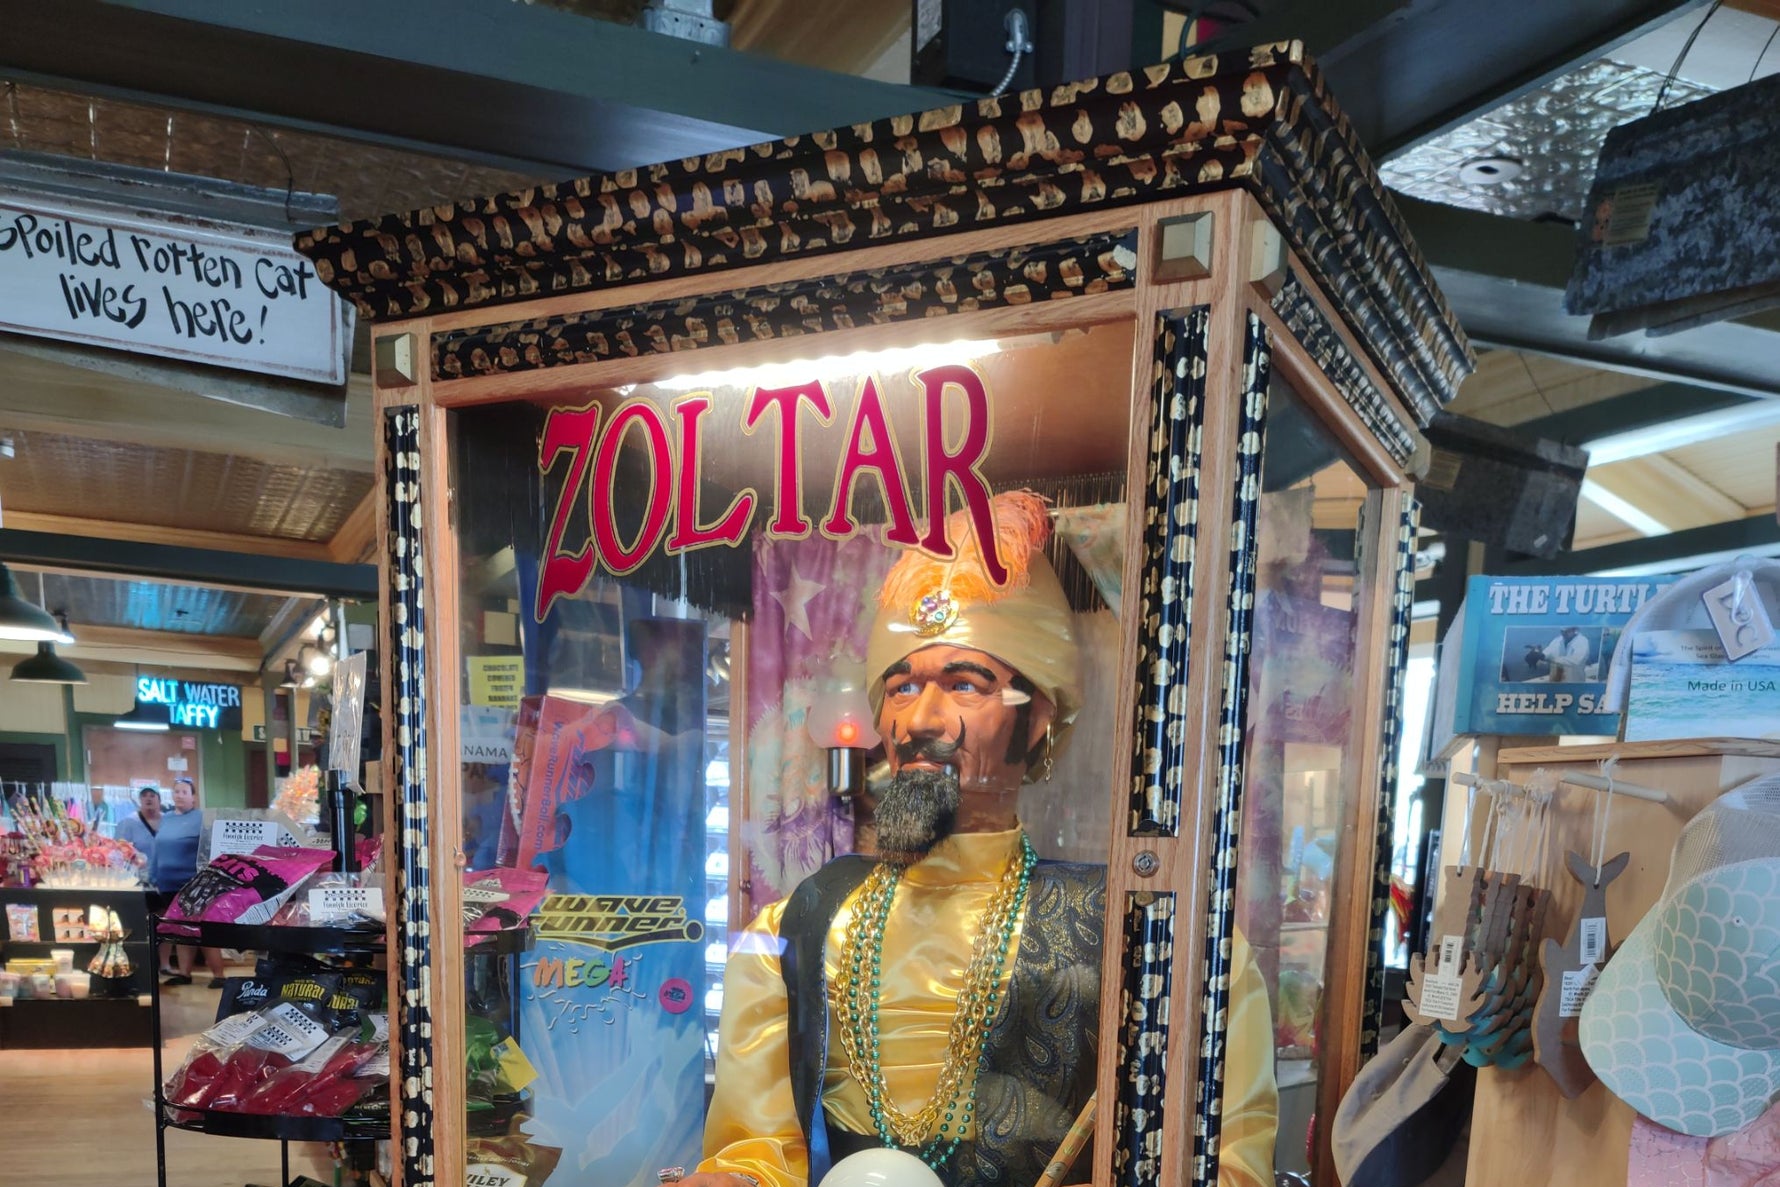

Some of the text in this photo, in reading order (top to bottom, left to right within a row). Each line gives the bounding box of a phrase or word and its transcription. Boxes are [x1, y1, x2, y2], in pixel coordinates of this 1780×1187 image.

[59, 273, 268, 344] lives here!
[534, 361, 1012, 623] ZOLTAR
[1489, 583, 1550, 615] THE
[138, 676, 240, 707] SALT WATER
[1687, 680, 1776, 692] Made in USA
[166, 701, 219, 728] TAFFY
[1496, 693, 1573, 715] HELP
[533, 956, 629, 989] MEGA
[236, 980, 268, 999] Panda
